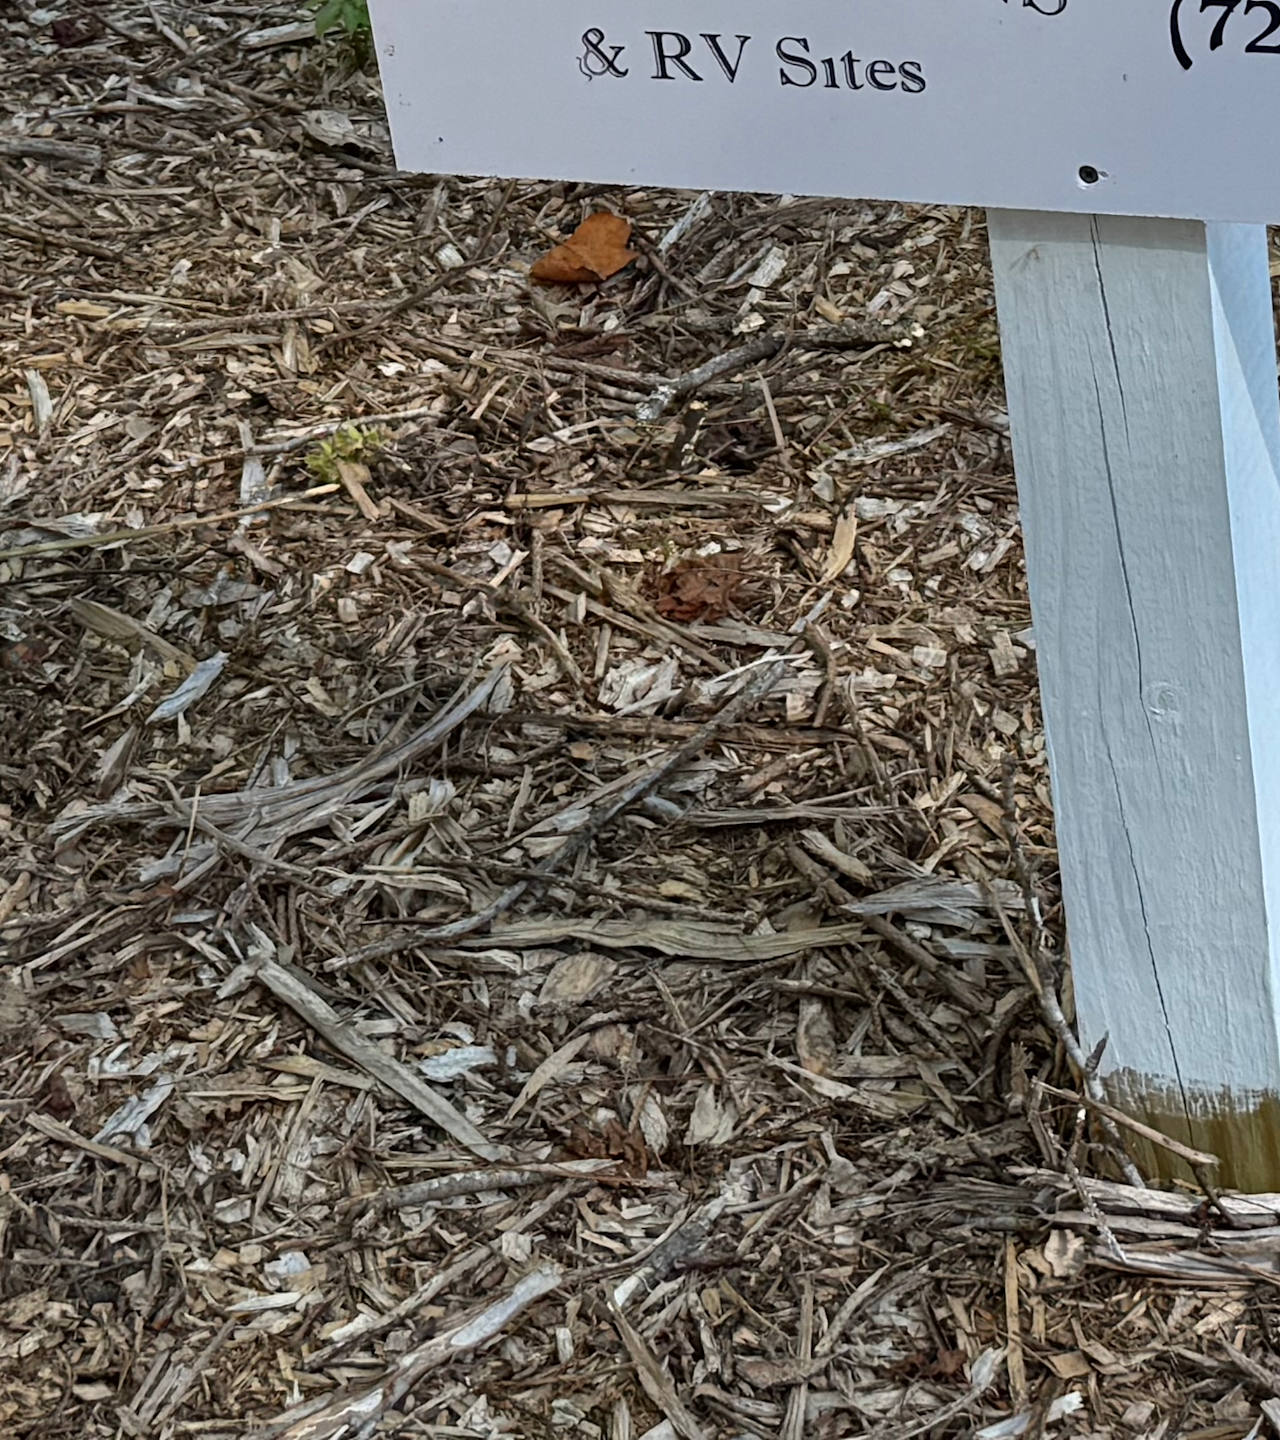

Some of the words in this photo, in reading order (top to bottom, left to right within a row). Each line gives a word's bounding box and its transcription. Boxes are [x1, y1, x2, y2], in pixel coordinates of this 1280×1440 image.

[576, 27, 629, 82] &
[644, 31, 751, 84] RV
[775, 36, 926, 94] Sites
